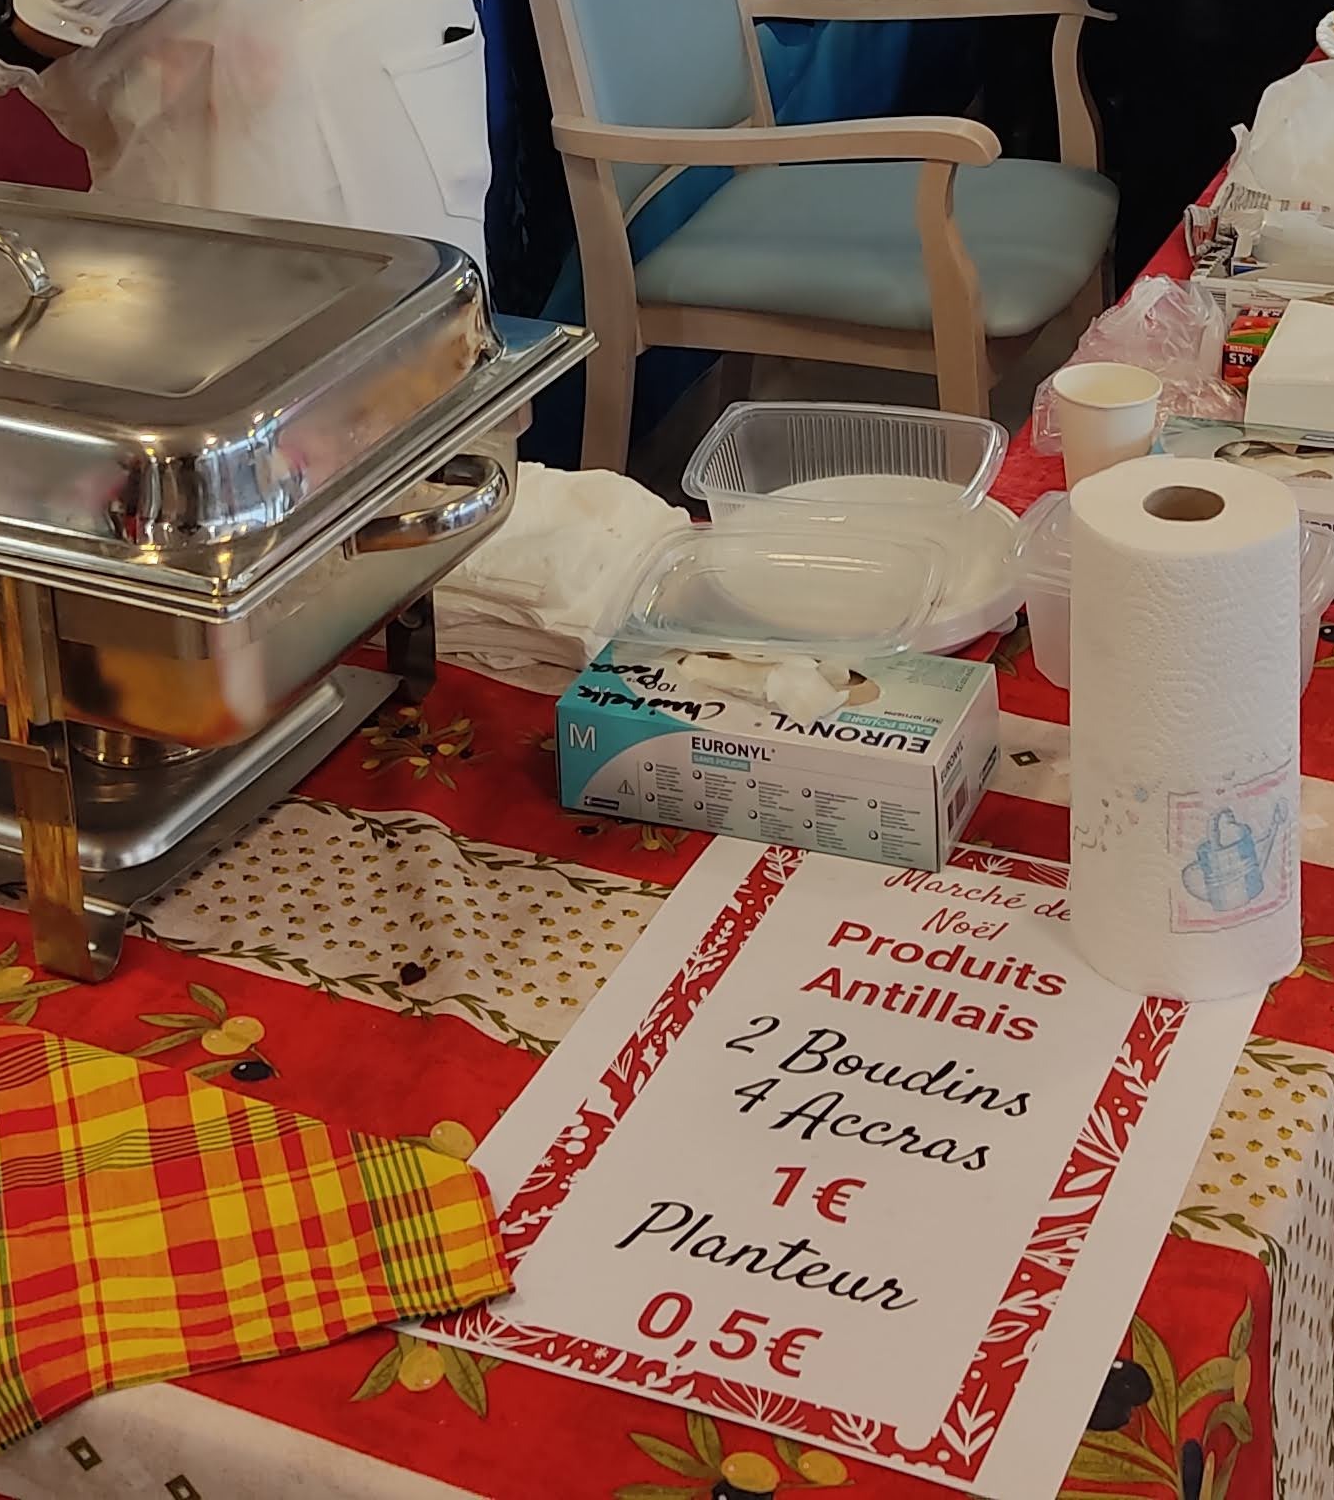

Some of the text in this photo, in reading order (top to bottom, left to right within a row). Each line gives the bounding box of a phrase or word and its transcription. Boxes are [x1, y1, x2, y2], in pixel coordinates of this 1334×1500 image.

[1228, 352, 1253, 366] x15
[568, 723, 596, 752] M
[691, 736, 771, 762] EURONYL
[770, 711, 932, 754] EURONYL
[841, 713, 897, 731] POUDRE
[884, 868, 1072, 922] Marché de
[921, 907, 1010, 941] Noël
[826, 918, 1068, 1000] Produits
[800, 965, 1041, 1043] Antillais
[724, 1015, 1032, 1119] 2 Boudins
[732, 1077, 990, 1173] 4 Accras
[770, 1164, 868, 1226] 1€
[613, 1199, 920, 1314] Planteur
[634, 1290, 824, 1380] 0,5€
